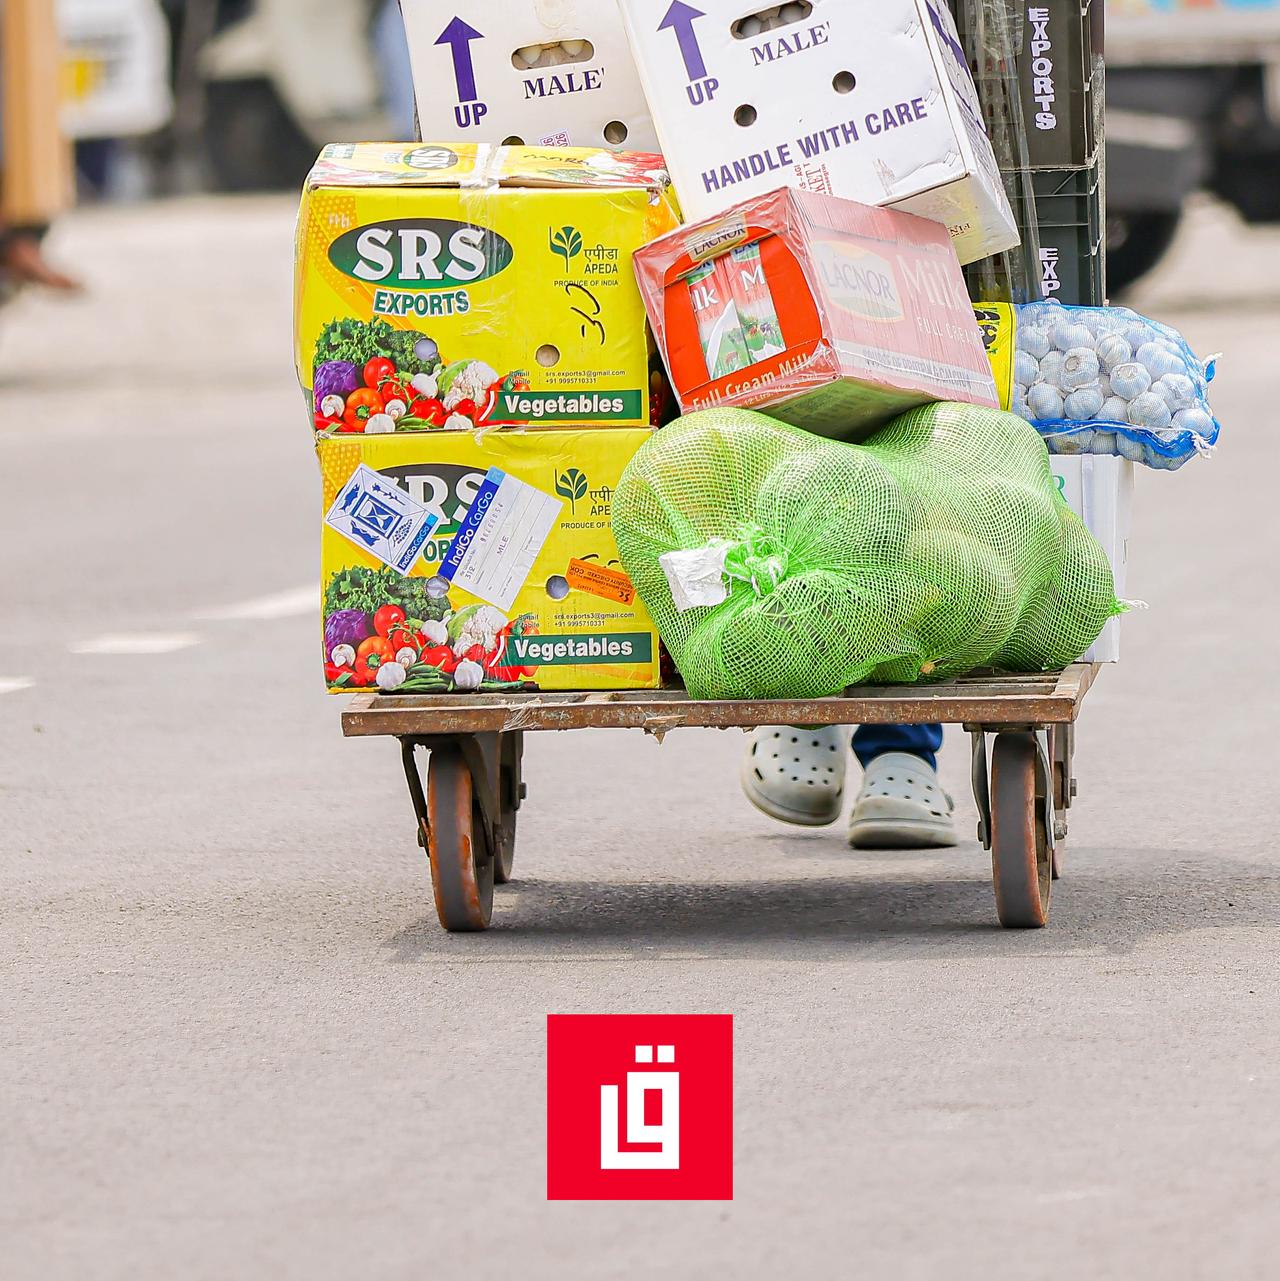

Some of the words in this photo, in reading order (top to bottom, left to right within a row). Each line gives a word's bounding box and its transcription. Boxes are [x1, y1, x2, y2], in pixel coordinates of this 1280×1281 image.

[1029, 7, 1056, 130] EXPORTS
[685, 78, 719, 106] UP
[454, 102, 488, 128] UP
[701, 144, 793, 193] HANDLE
[797, 122, 860, 159] WITH
[865, 97, 928, 135] CARE
[694, 222, 746, 255] LACNOR
[352, 228, 487, 281] SRS
[584, 246, 619, 262] एपीडा
[584, 263, 619, 274] APEDA
[821, 258, 895, 302] LACNOR
[1038, 247, 1061, 303] EXP
[373, 291, 469, 316] EXPORTS
[917, 316, 943, 337] FULL
[545, 370, 626, 378] srs.exports3@gmail.com
[505, 393, 624, 417] Vegetables
[693, 390, 720, 412] Full
[724, 372, 774, 400] Cream
[392, 475, 490, 526] RS
[448, 528, 474, 567] IndiGo
[468, 491, 493, 526] CarGo
[399, 547, 417, 568] IndiGo
[413, 525, 430, 547] CarGo
[497, 535, 509, 556] MLE
[513, 637, 633, 660] Vegetables
